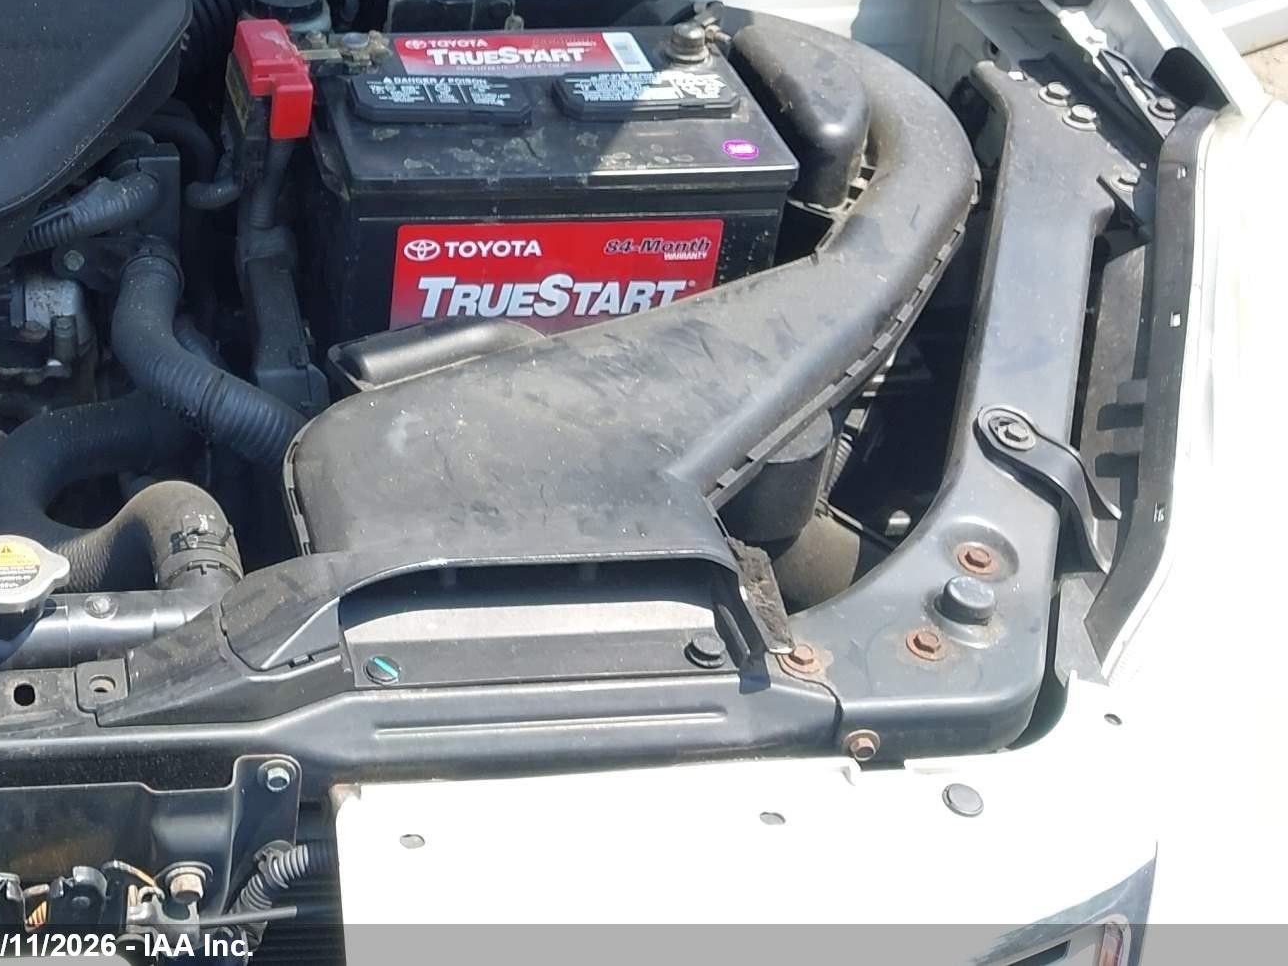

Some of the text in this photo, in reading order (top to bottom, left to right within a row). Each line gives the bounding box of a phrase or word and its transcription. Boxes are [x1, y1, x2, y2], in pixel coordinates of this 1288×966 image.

[427, 39, 488, 49] TOYOTA
[444, 240, 543, 258] TOYOTA
[604, 236, 711, 255] 84-Month
[662, 251, 708, 261] WARRANTY
